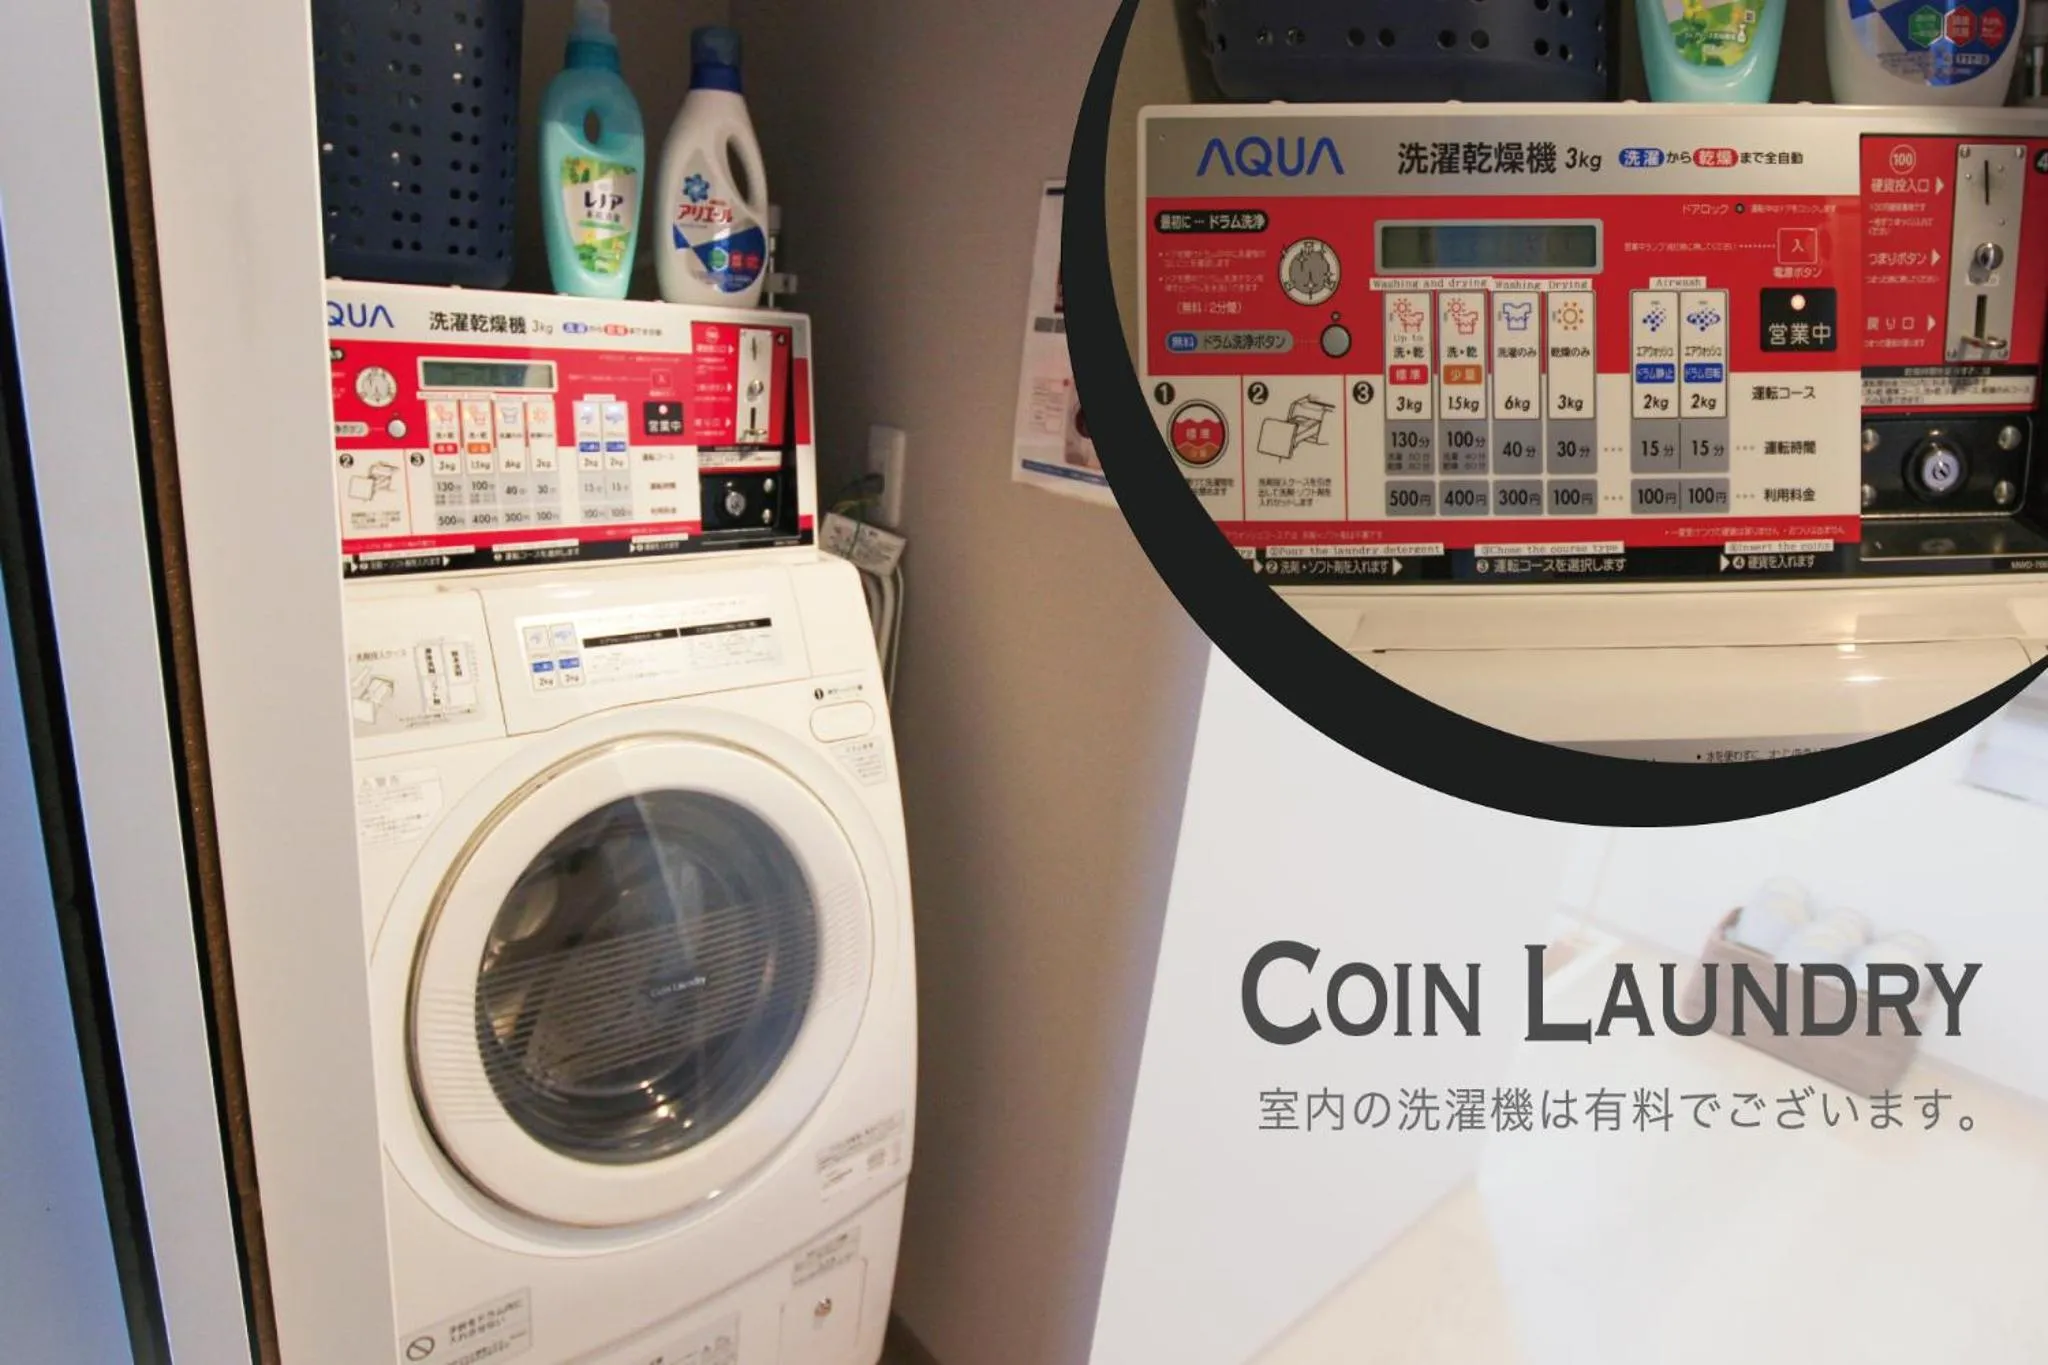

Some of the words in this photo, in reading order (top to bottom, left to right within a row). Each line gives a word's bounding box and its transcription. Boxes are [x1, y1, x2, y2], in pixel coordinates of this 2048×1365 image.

[1196, 136, 1345, 177] AQUA
[1397, 142, 1557, 176] 洗濯乾燥機
[1565, 147, 1602, 173] 3kg
[677, 203, 733, 224] アリエール
[327, 300, 395, 328] QUA
[430, 311, 527, 335] 洗濯乾燥機
[1768, 322, 1832, 345] 営業中
[1752, 385, 1816, 401] 運転コース
[1396, 396, 1423, 413] 3kg
[1505, 394, 1531, 412] 6kg
[1557, 394, 1584, 412] 3kg
[1644, 394, 1669, 411] 2kg
[1691, 394, 1716, 411] 2kg
[1391, 430, 1430, 447] 130分
[1447, 430, 1486, 447] 100分
[1502, 441, 1536, 458] 40分
[1557, 441, 1590, 458] 30分
[1641, 440, 1674, 457] 15分
[1692, 440, 1725, 457] 15分
[1764, 441, 1817, 455] 運転時間
[1389, 490, 1431, 507] 500円
[1444, 490, 1487, 507] 400円
[1499, 489, 1541, 507] 300円
[1553, 489, 1593, 506] 100円
[1638, 488, 1676, 505] 100円
[1688, 488, 1727, 505] 100円
[1764, 489, 1816, 503] 利用料金
[1494, 557, 1627, 573] 運転コースを選択します
